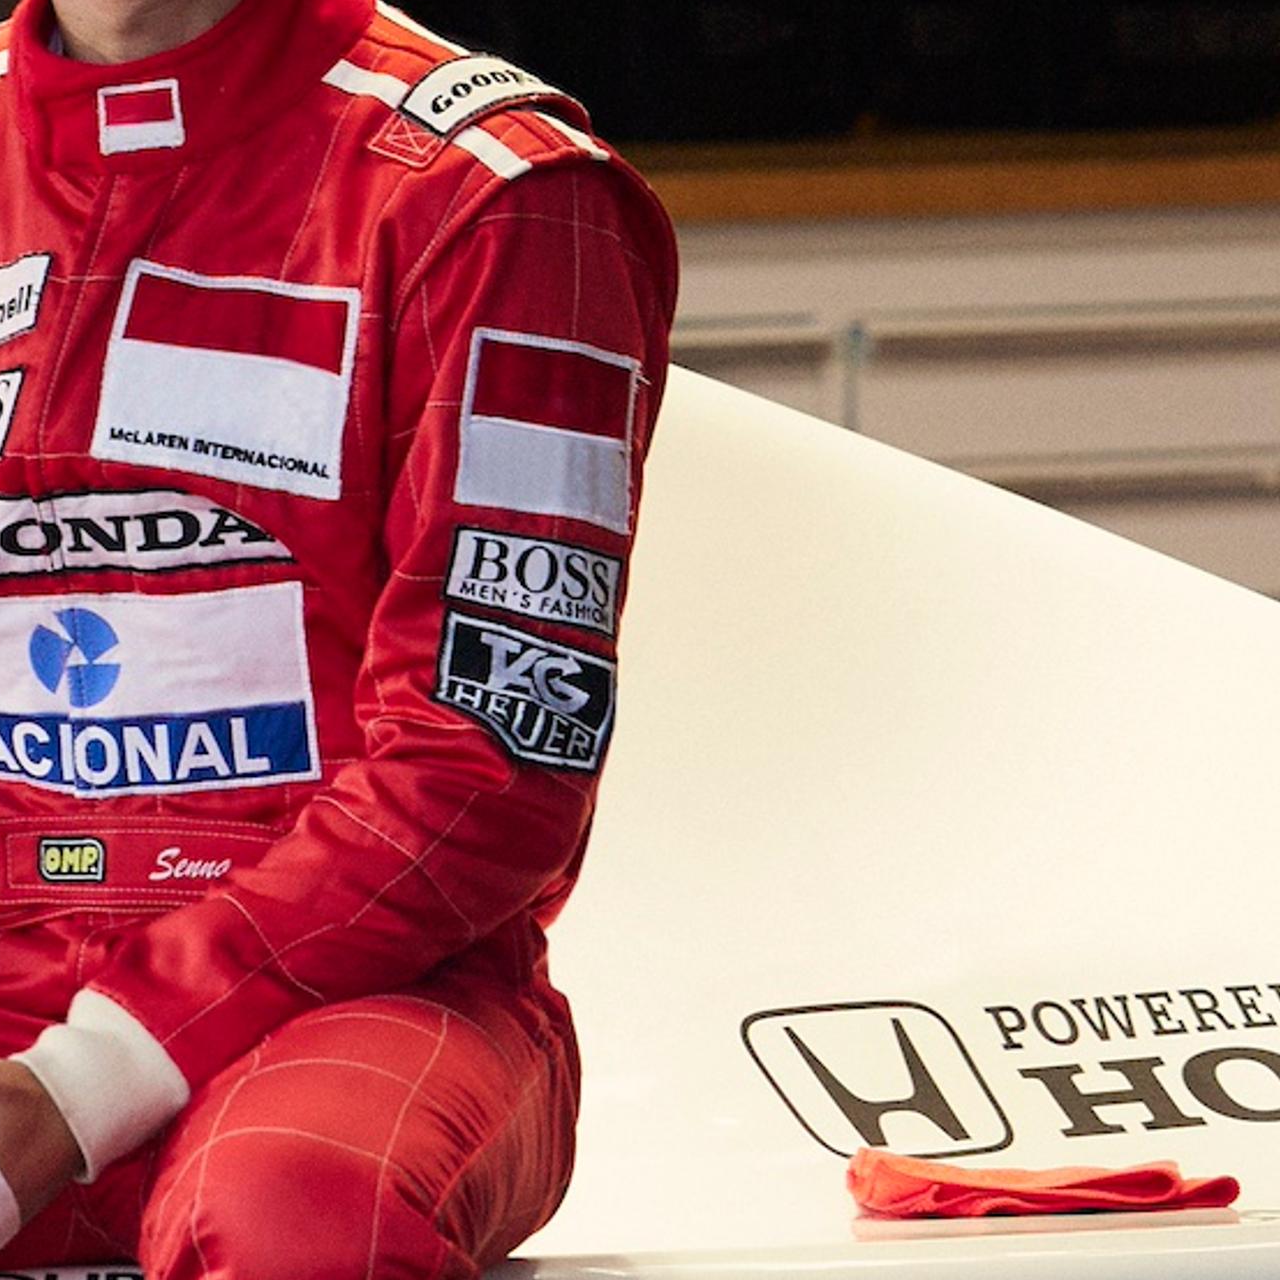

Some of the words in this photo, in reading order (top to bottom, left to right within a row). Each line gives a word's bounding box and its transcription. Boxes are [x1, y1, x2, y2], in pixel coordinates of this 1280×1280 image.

[109, 427, 188, 452] McLAREN
[193, 439, 330, 478] INTERNACIONAL
[466, 536, 610, 608] BOSS
[539, 596, 608, 625] FASHIO
[454, 683, 590, 757] HEUER
[1018, 1045, 1280, 1138] HO
